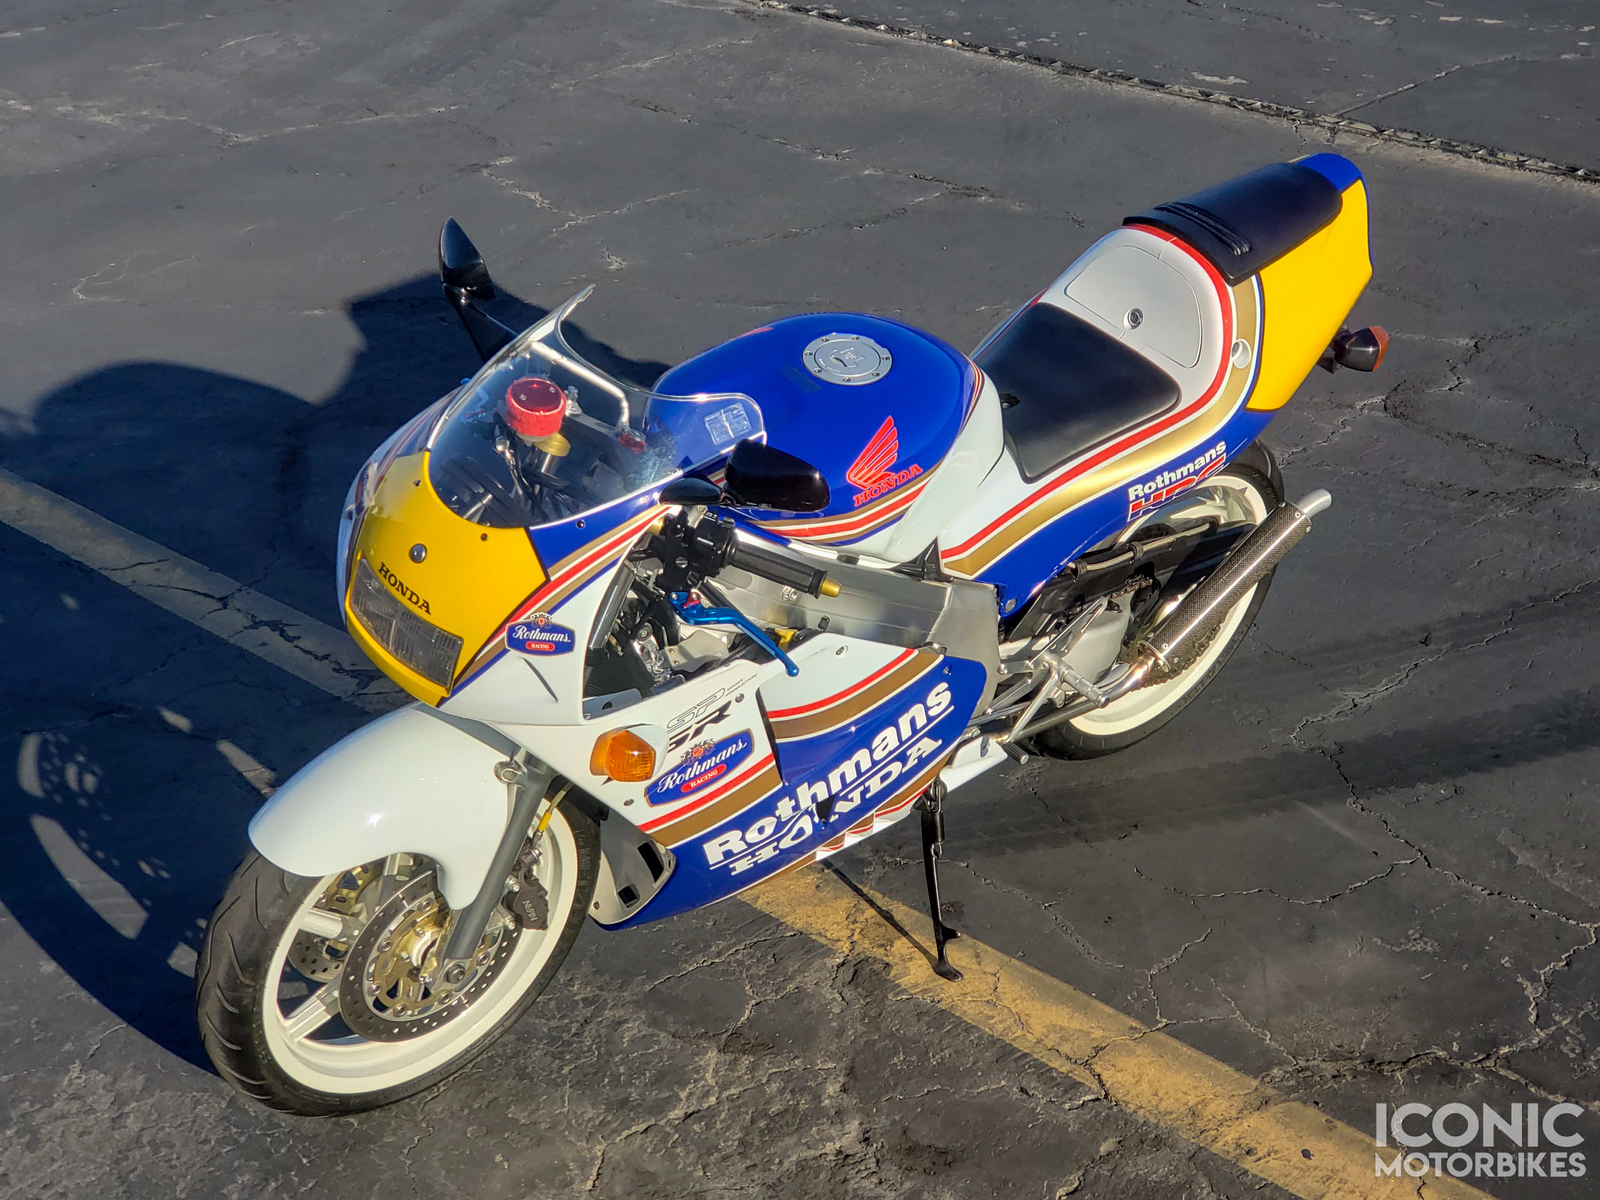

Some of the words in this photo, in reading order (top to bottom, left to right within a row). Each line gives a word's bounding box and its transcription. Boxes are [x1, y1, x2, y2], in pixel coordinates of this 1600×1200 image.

[853, 463, 924, 507] HONDA
[1128, 440, 1227, 502] Rothmans
[378, 561, 432, 616] HONDA
[512, 624, 572, 643] Rothmans
[531, 642, 550, 651] RACING
[657, 738, 748, 793] Rothmans
[689, 769, 719, 789] RACING
[702, 682, 952, 866] Rothmans
[729, 737, 943, 876] HONDA
